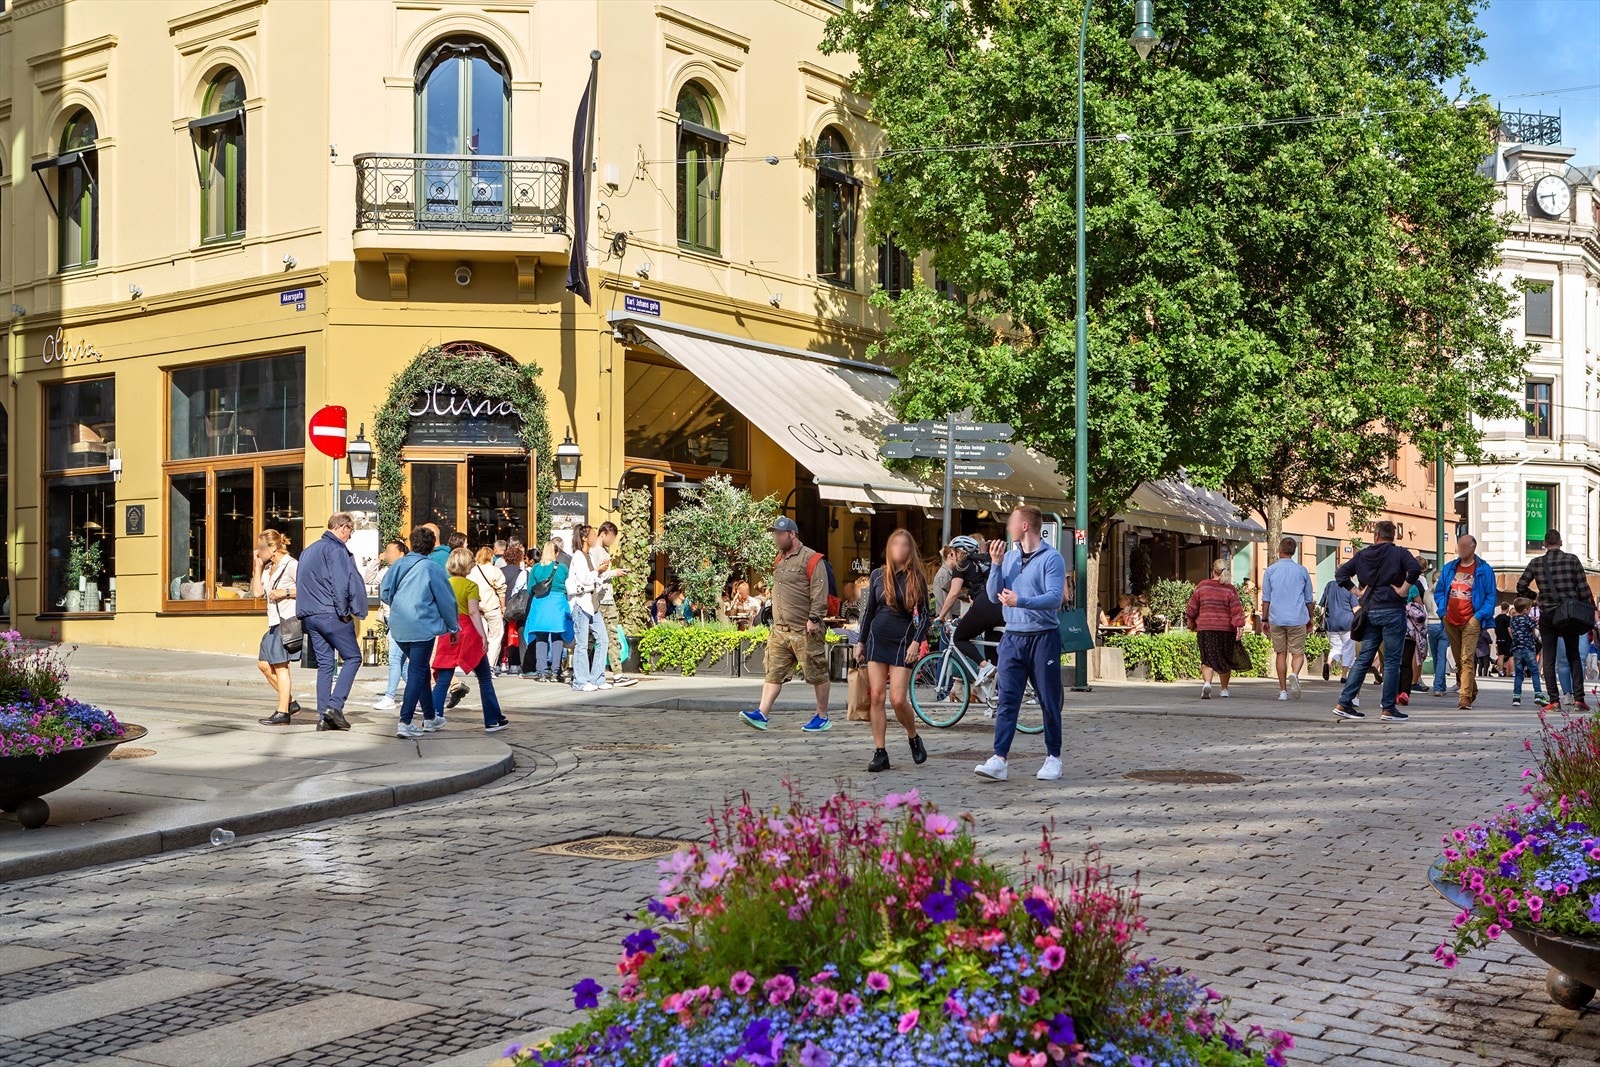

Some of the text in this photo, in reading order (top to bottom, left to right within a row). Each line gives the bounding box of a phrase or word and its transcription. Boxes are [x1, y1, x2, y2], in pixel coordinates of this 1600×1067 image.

[282, 292, 303, 302] Akersgata
[627, 297, 635, 306] Karl
[636, 299, 649, 308] Johans
[43, 326, 102, 363] Olivia
[787, 423, 887, 462] Olivi
[345, 493, 377, 506] Olivia
[552, 494, 584, 507] Olivia
[1526, 510, 1543, 518] 70%
